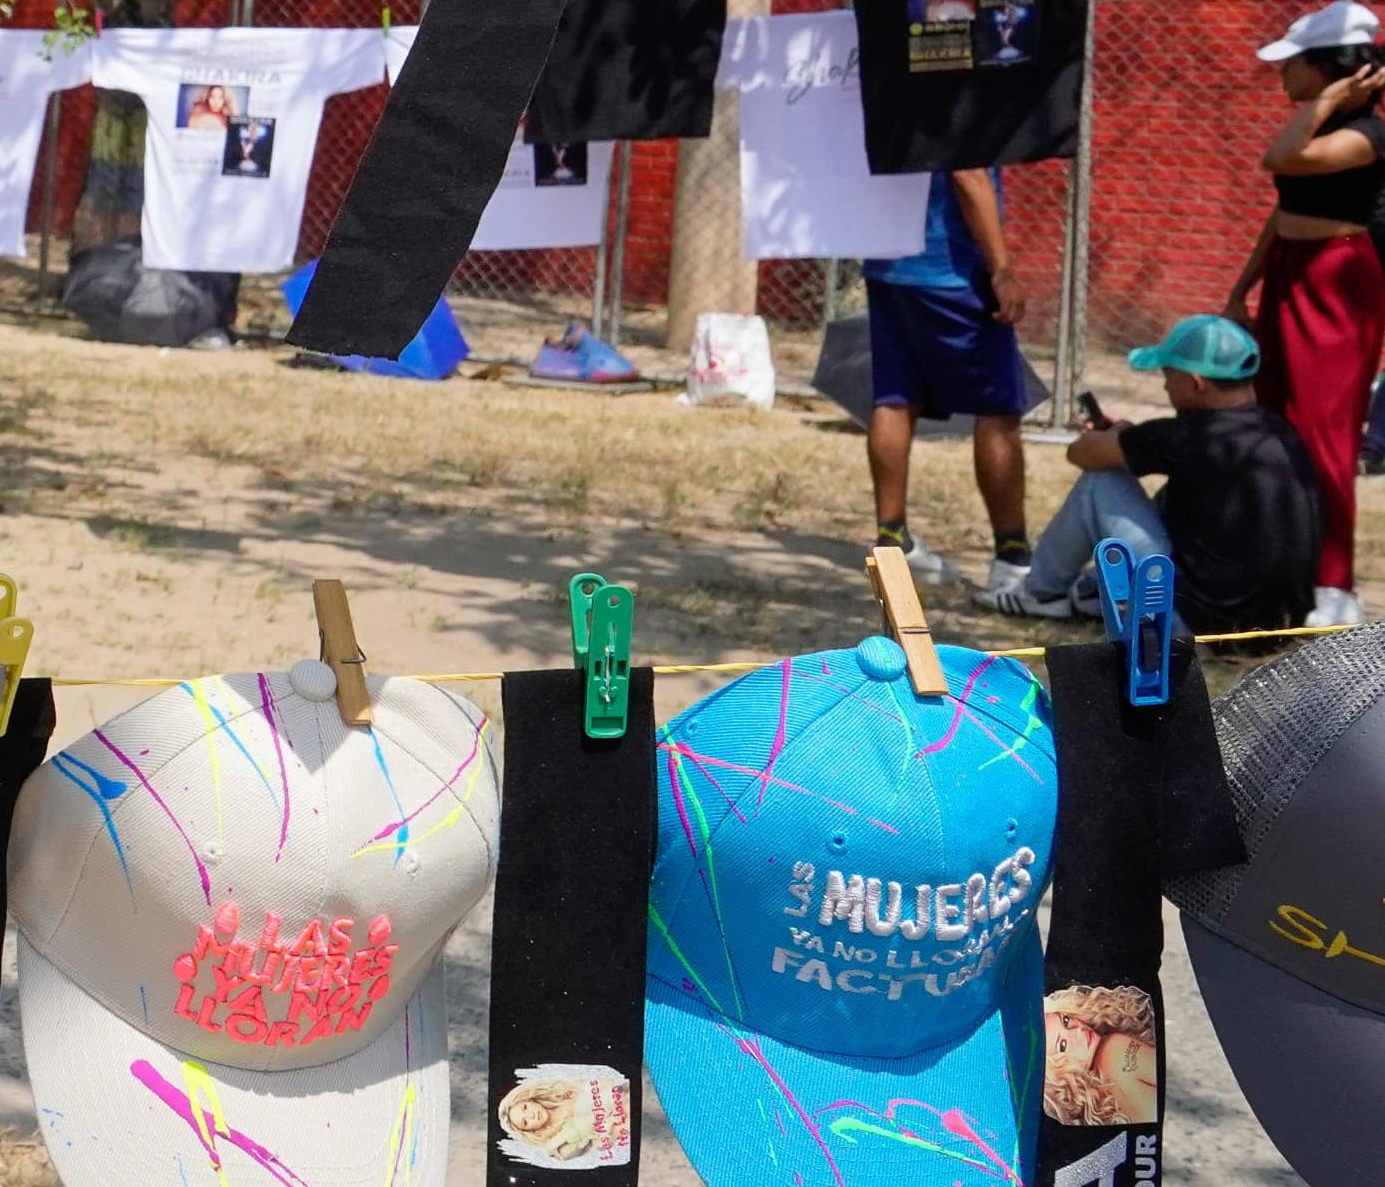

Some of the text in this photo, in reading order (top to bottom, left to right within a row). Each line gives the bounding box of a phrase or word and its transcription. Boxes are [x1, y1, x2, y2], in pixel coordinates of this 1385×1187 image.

[783, 860, 816, 918] LAS
[193, 923, 399, 994] MUJERES
[259, 910, 355, 957] LAS
[789, 926, 825, 954] YA
[832, 941, 878, 964] NO
[174, 982, 374, 1048] LLORAN
[212, 967, 363, 1025] YA NO
